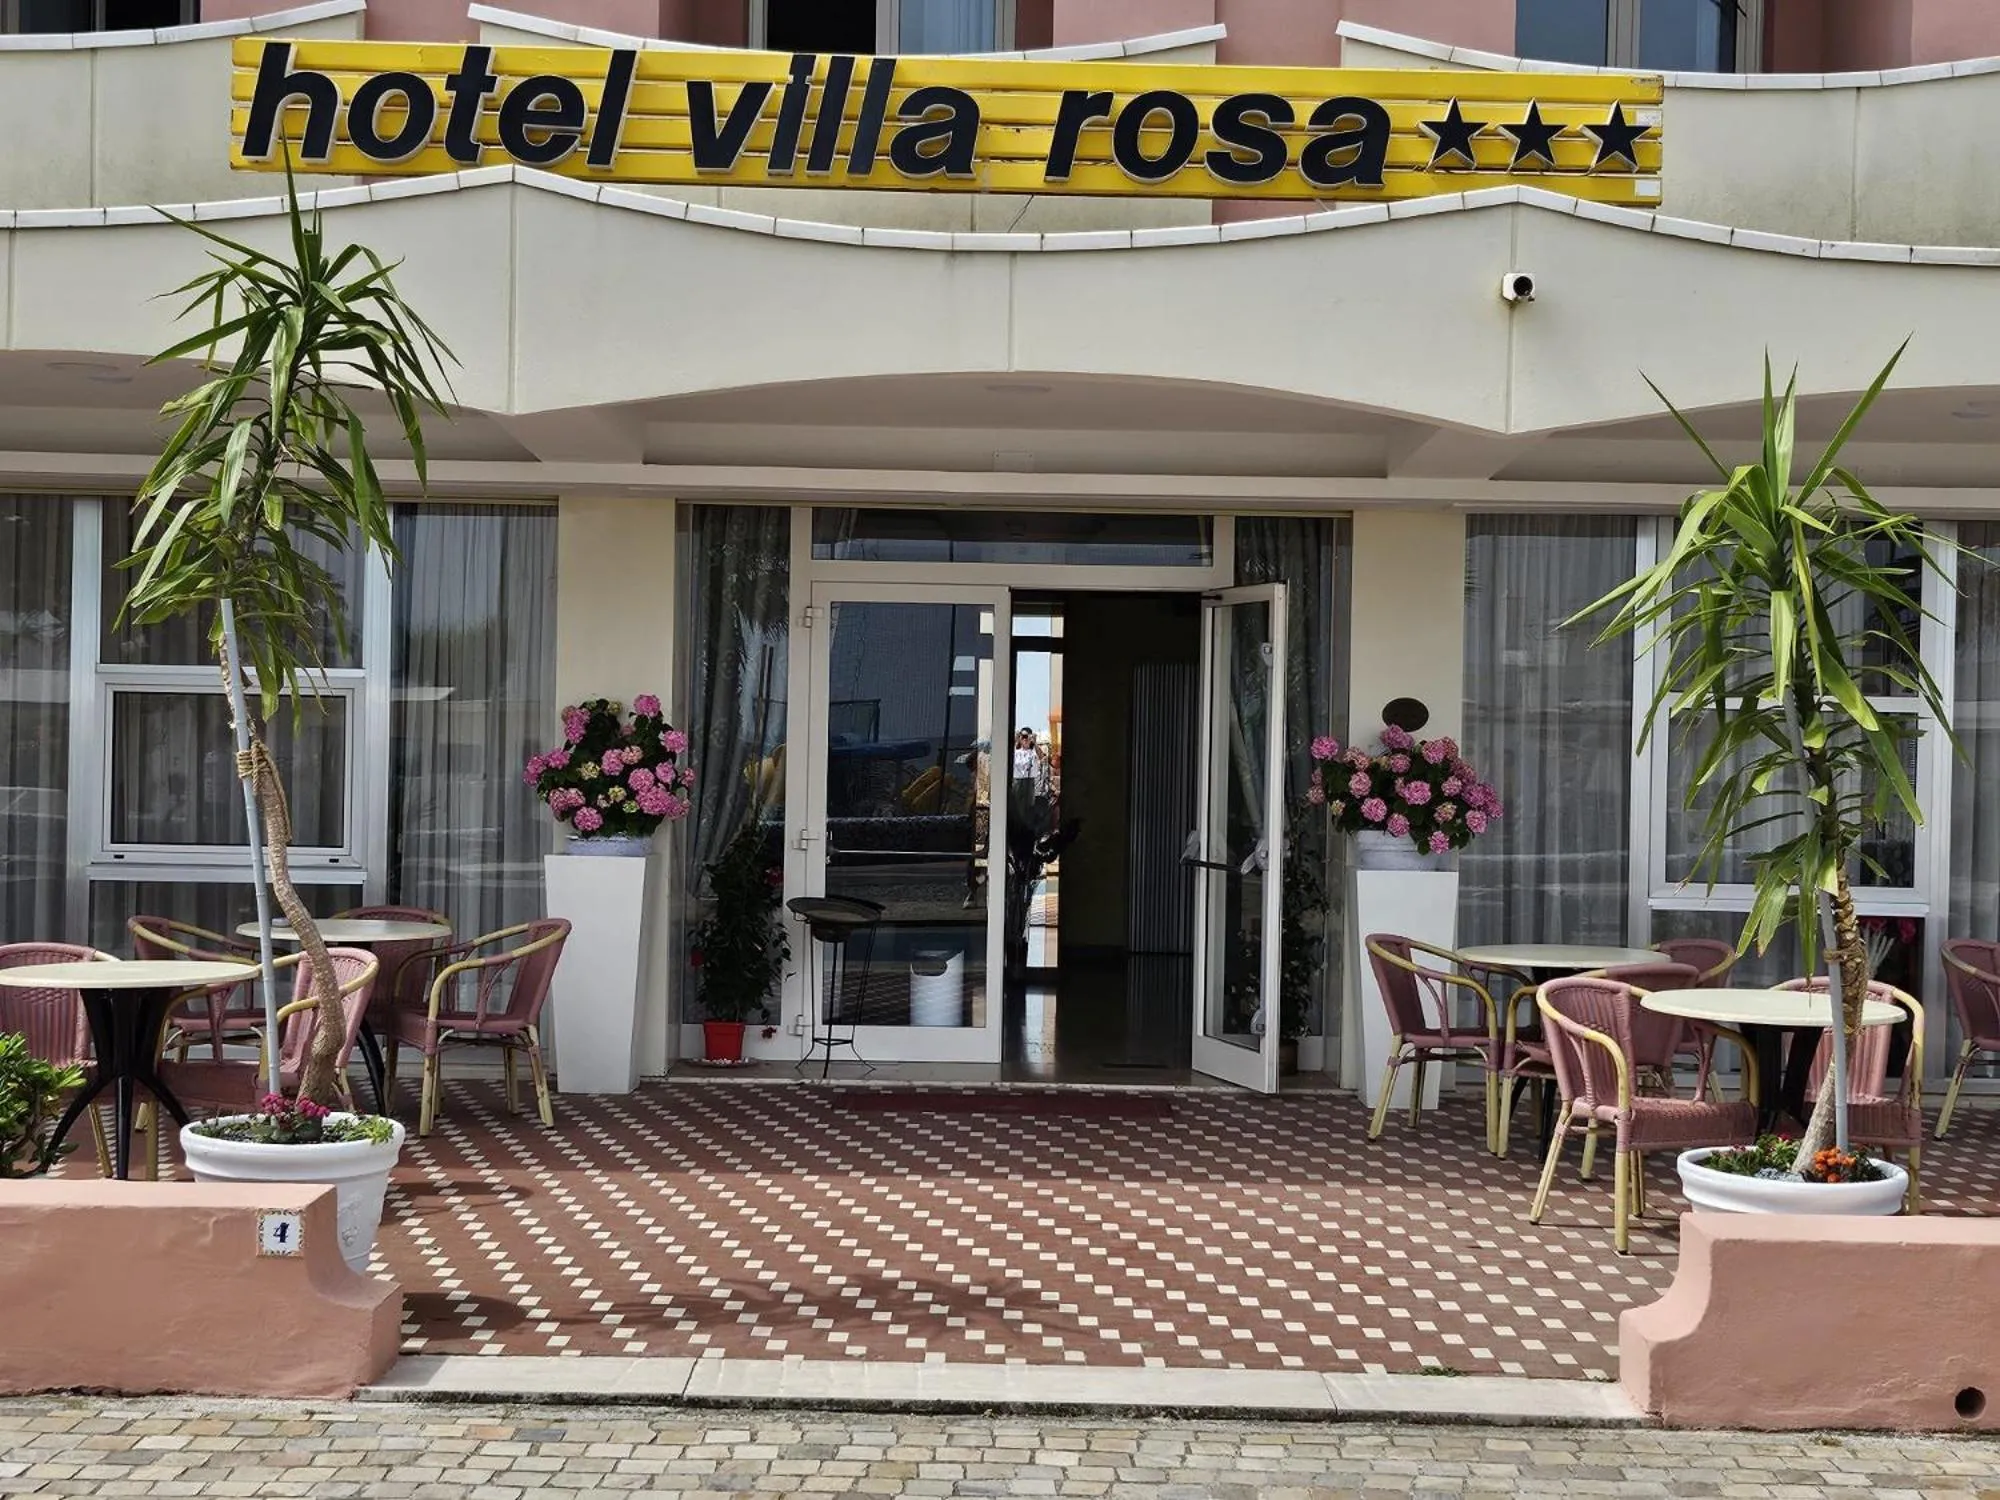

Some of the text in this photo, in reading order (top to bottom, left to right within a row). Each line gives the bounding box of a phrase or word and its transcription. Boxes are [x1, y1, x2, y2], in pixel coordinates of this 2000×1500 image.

[241, 42, 1391, 188] hotel villa rosa
[272, 1222, 290, 1243] 4
